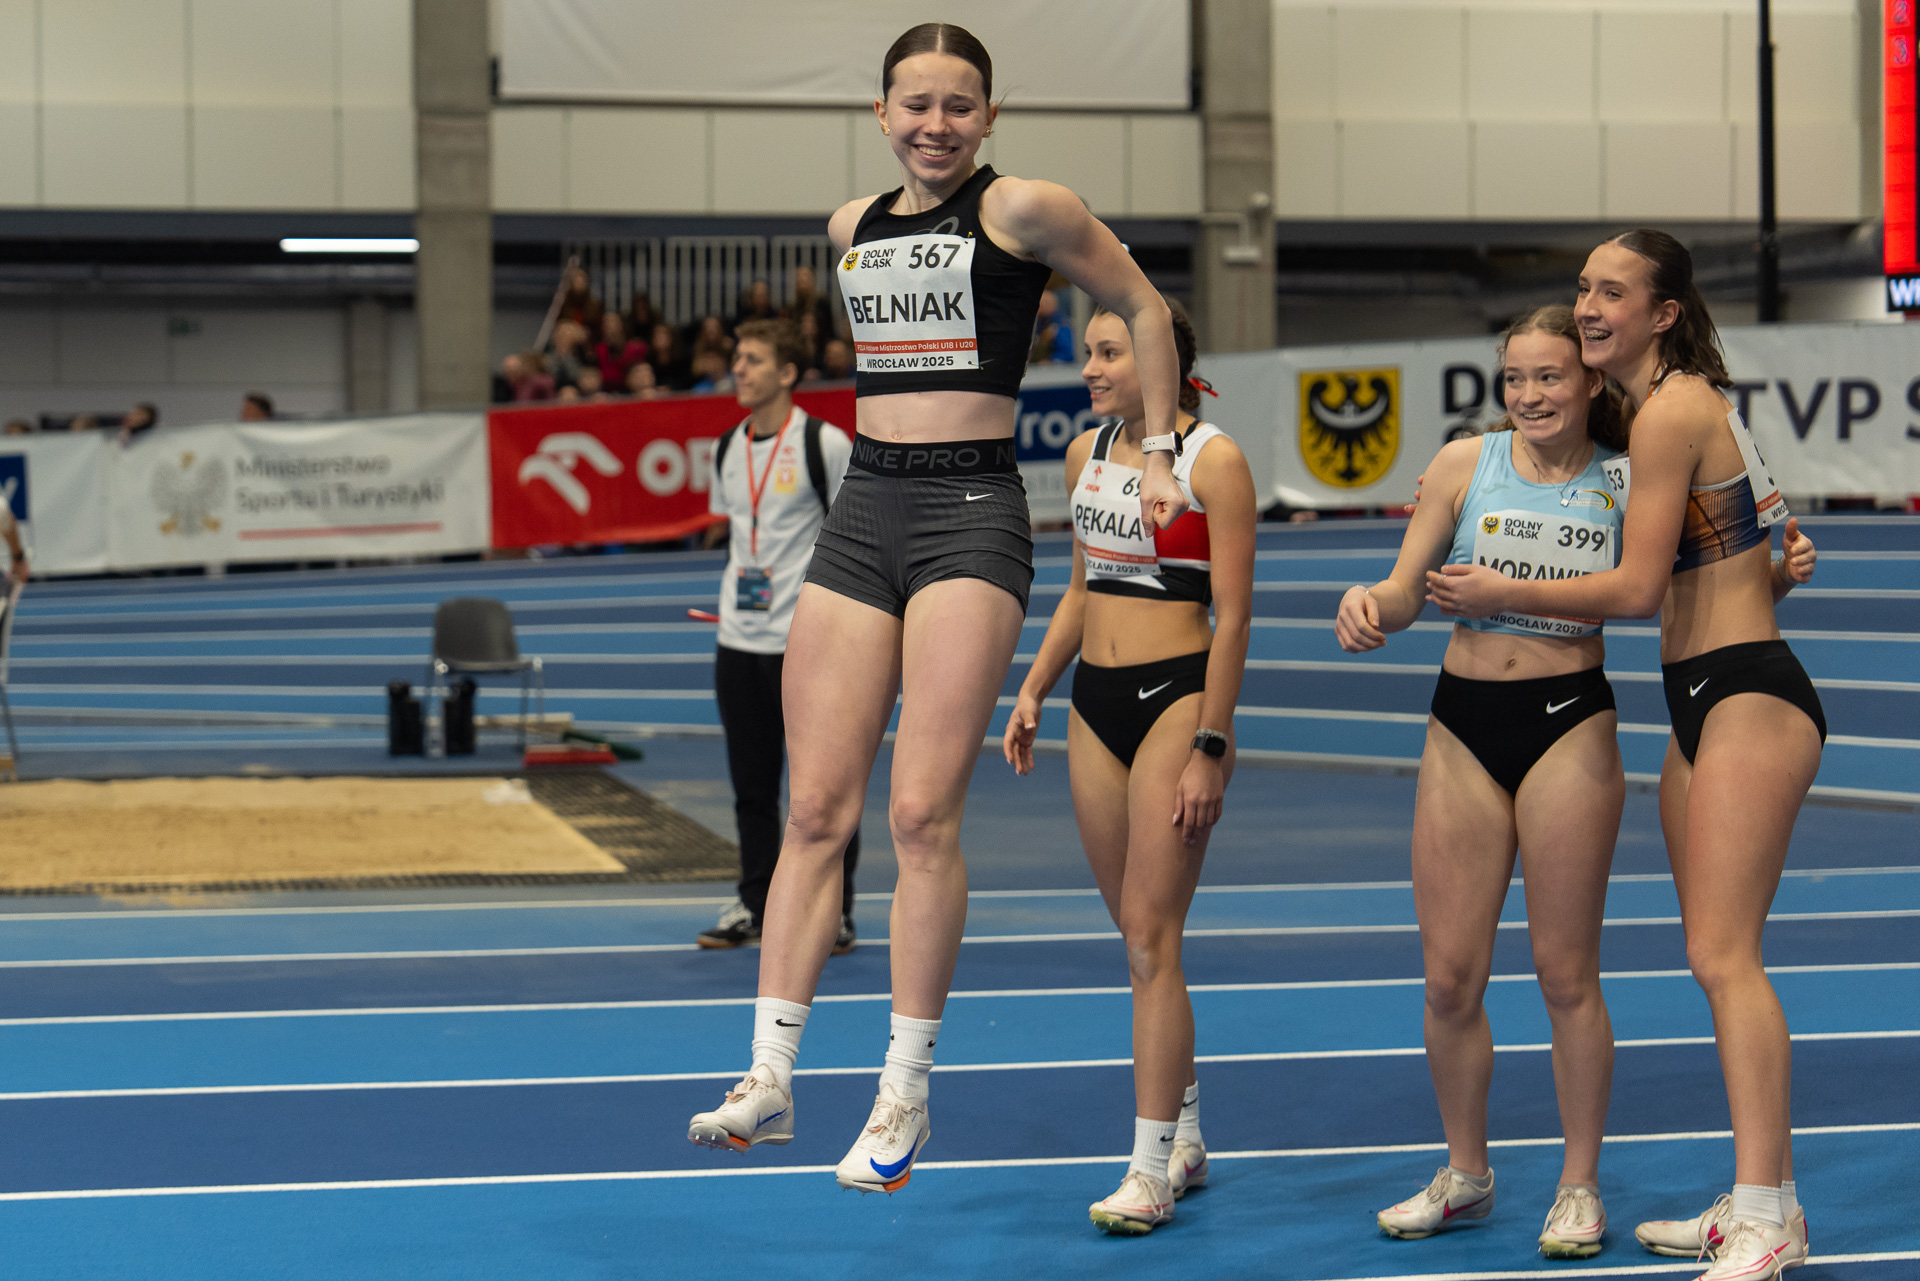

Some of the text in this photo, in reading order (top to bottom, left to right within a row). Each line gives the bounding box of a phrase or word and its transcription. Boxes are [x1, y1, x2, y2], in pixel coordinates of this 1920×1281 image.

[863, 247, 897, 260] DOLNY
[908, 243, 961, 269] 567
[849, 291, 967, 324] BELNIAK
[918, 343, 940, 351] Polski
[940, 342, 954, 350] U18
[959, 341, 974, 349] U20
[866, 356, 954, 369] WROCŁAW 2025
[1728, 376, 1882, 441] TVP
[852, 440, 901, 469] NIKE
[905, 447, 981, 469] PRO
[1075, 504, 1142, 541] PĘKALA
[1505, 517, 1544, 531] DOLNY
[1557, 525, 1606, 552] 399
[1115, 564, 1141, 573] 2025
[1489, 613, 1553, 631] WROCŁAW
[1555, 623, 1583, 635] 2025
